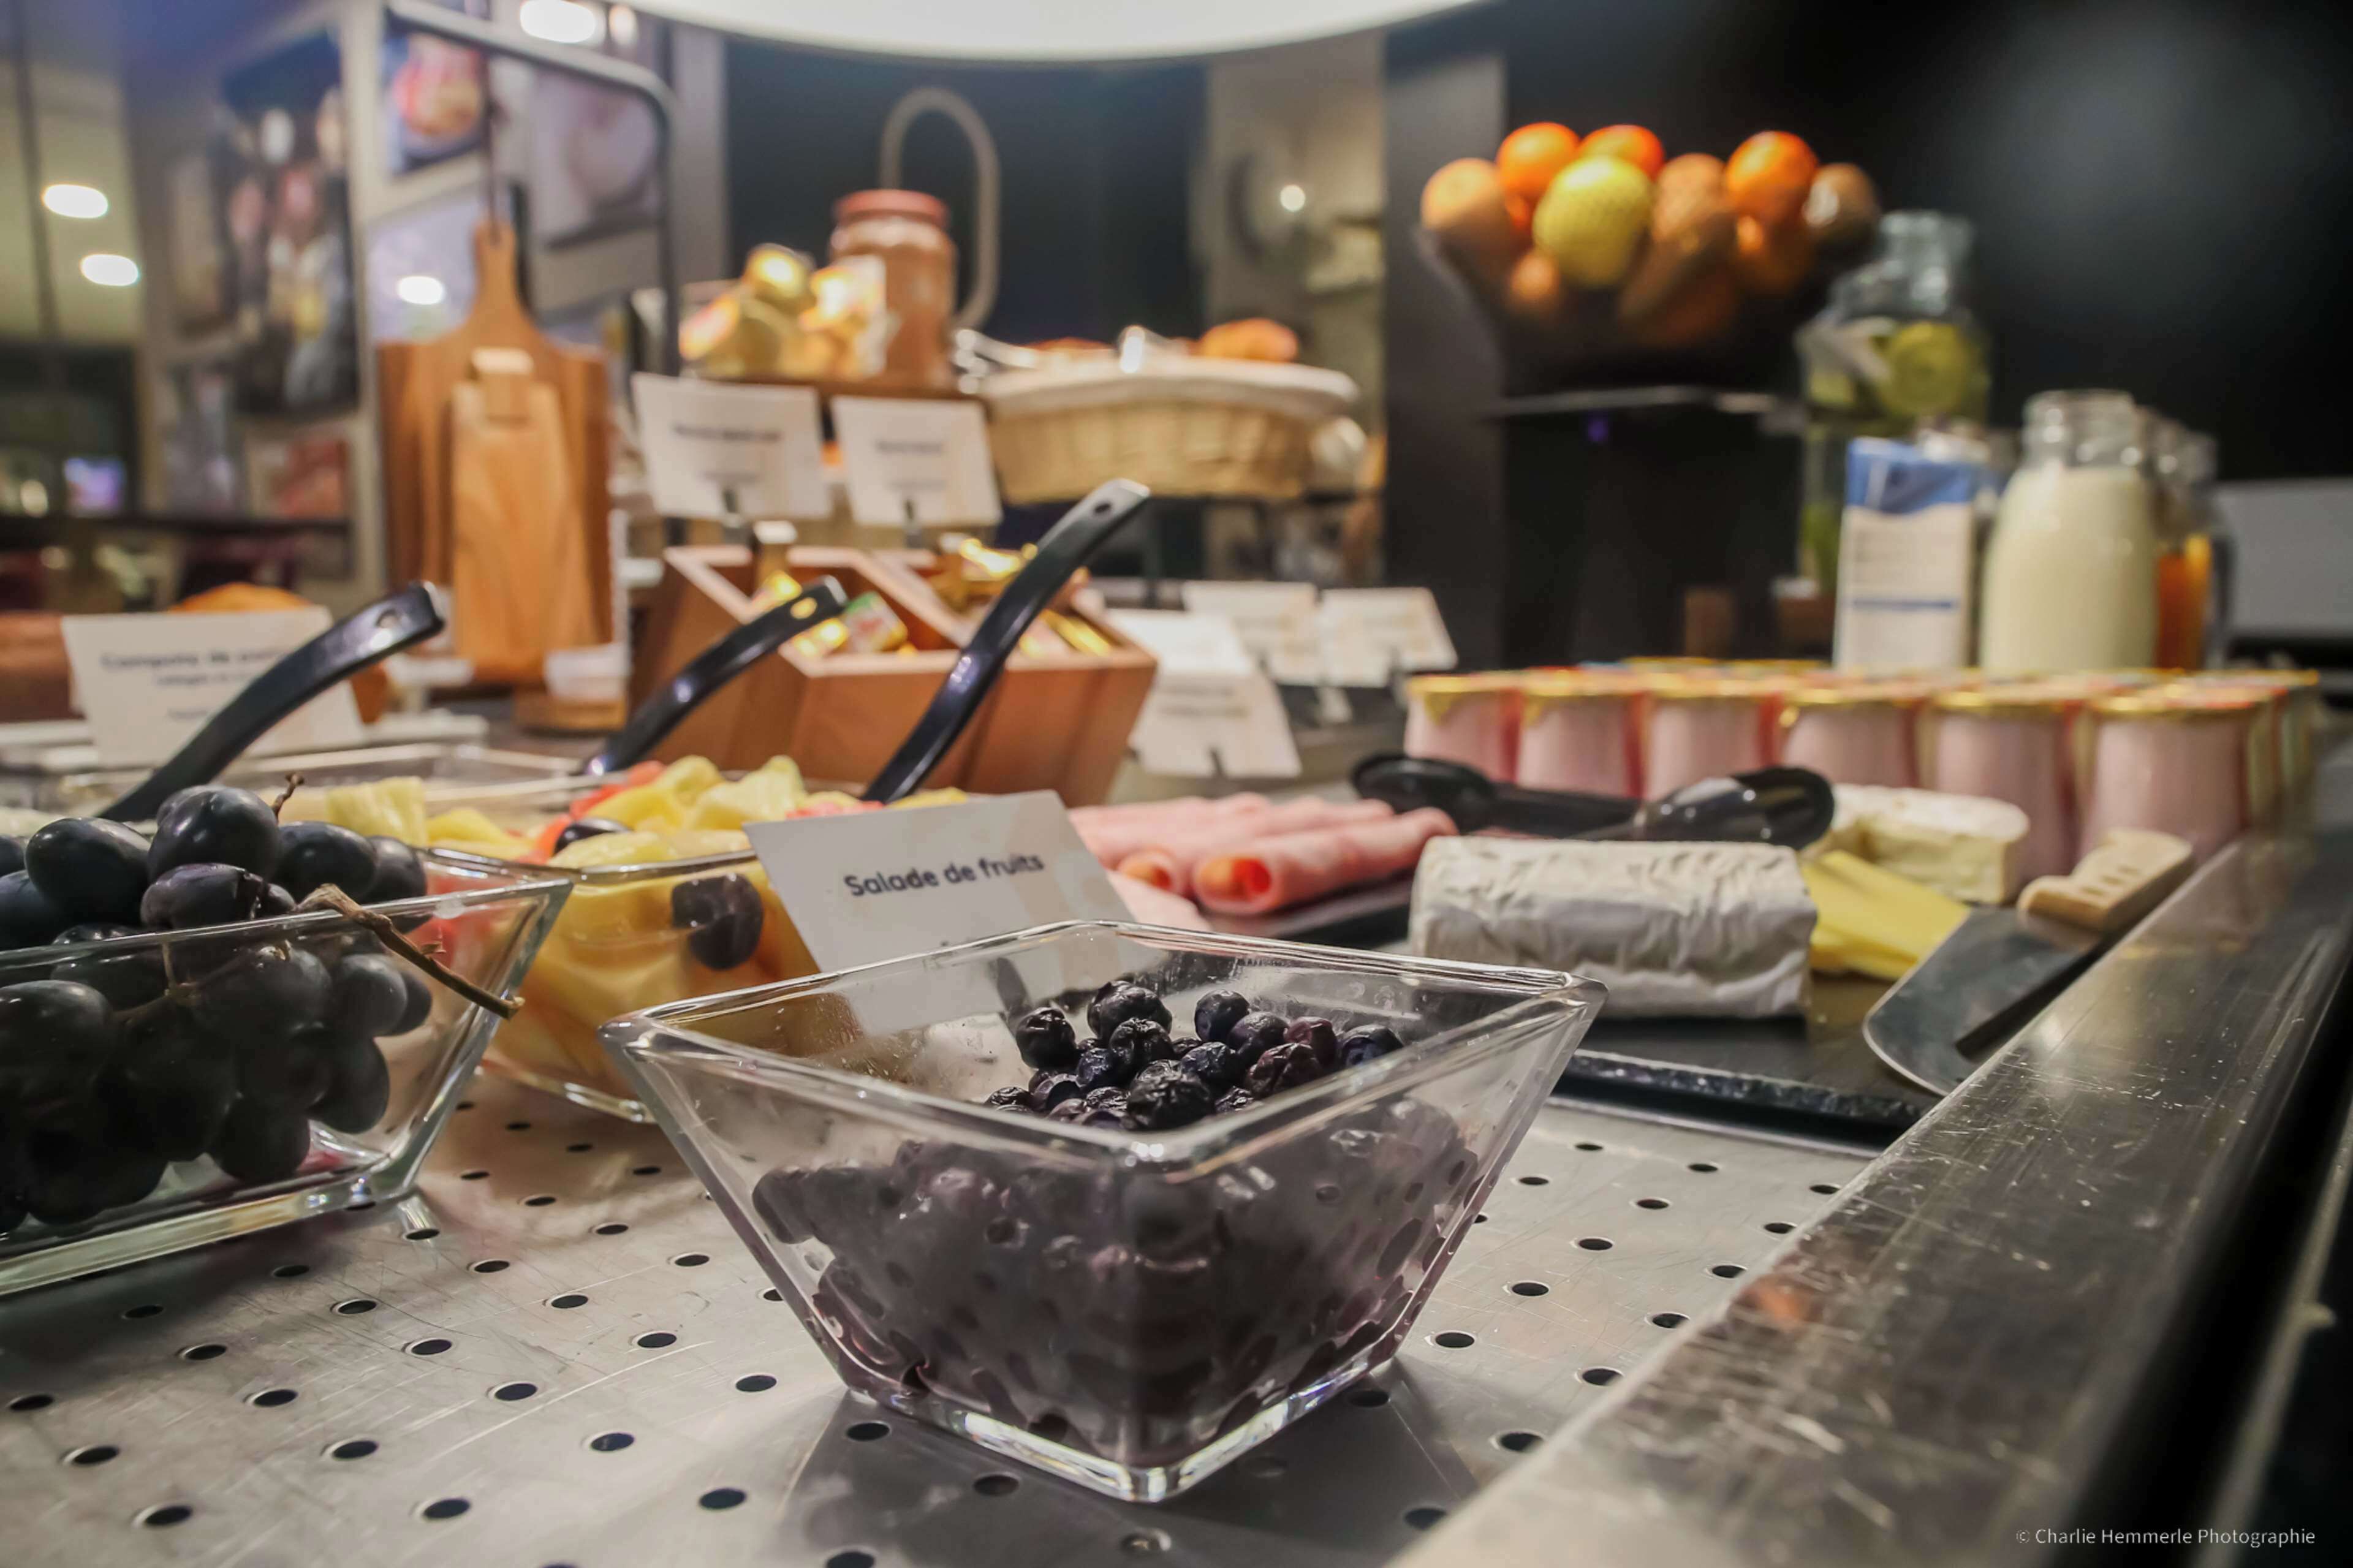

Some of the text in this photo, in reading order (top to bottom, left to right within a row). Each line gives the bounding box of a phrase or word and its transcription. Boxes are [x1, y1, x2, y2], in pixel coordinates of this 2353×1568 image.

[844, 855, 1045, 896] Salade de fruits
